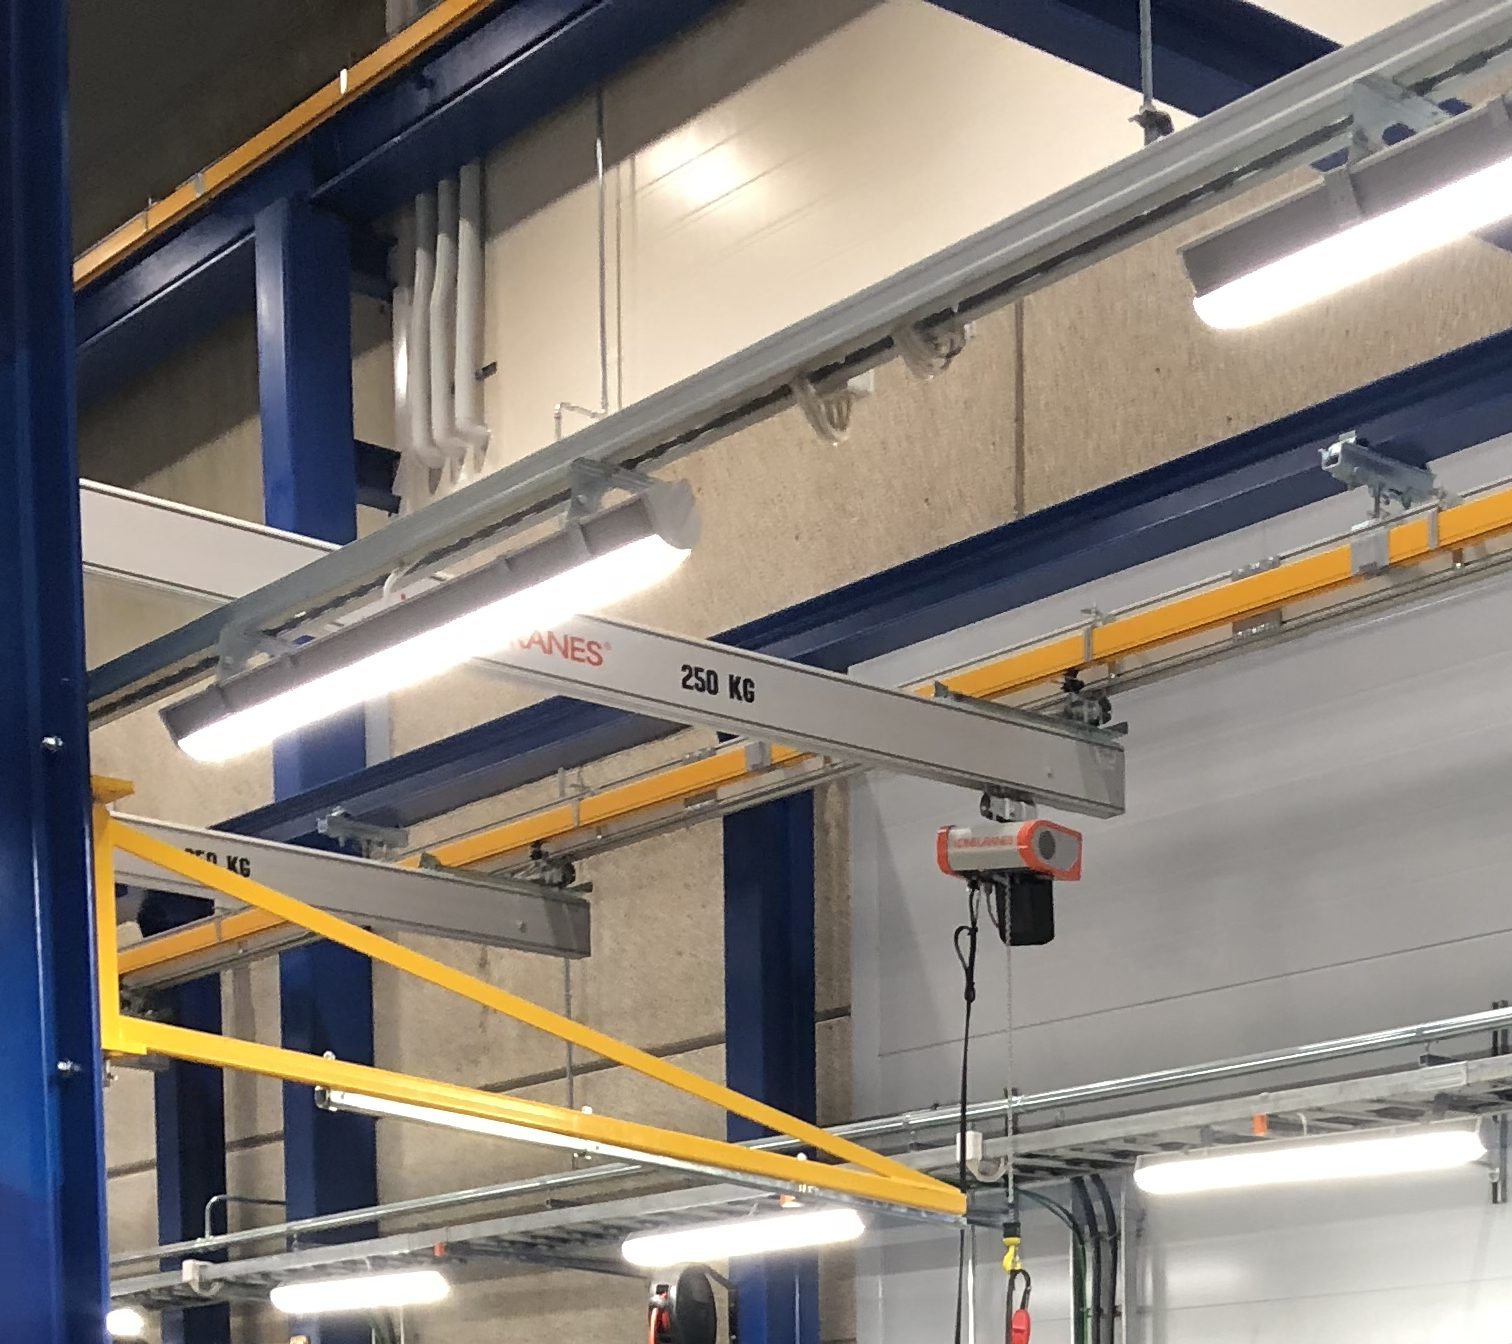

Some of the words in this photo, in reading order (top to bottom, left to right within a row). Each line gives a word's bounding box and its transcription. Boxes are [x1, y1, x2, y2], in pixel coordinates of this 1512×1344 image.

[681, 664, 719, 696] 250
[729, 674, 755, 703] KG
[226, 855, 251, 878] KG
